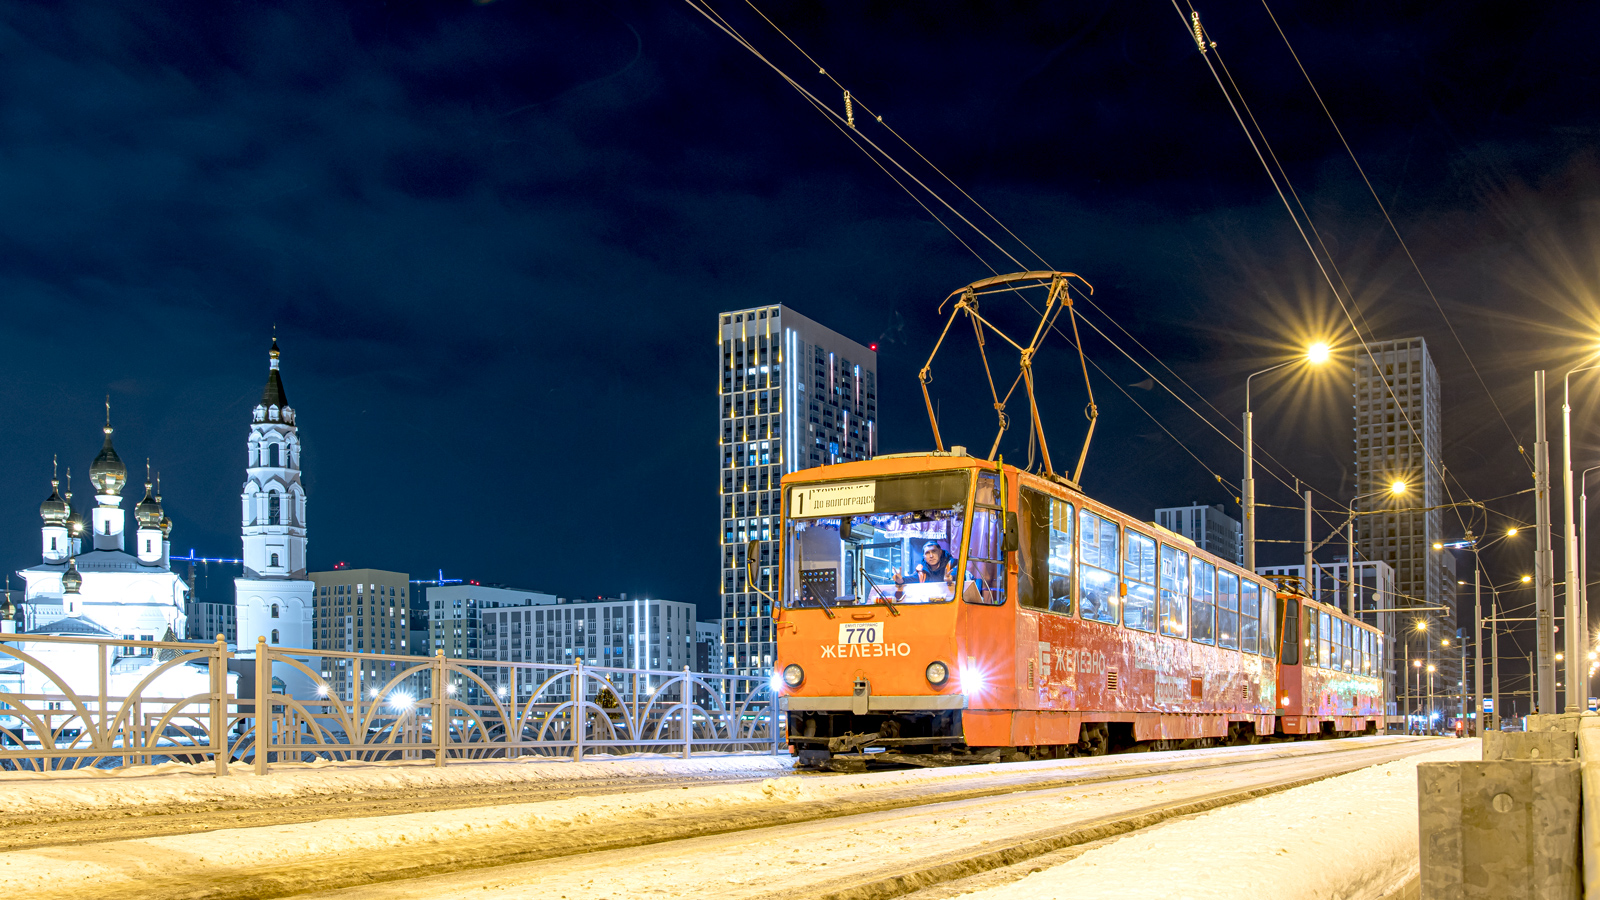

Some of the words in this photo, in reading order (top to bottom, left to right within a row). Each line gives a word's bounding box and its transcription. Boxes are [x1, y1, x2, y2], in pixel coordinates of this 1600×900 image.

[798, 492, 804, 515] 1
[846, 627, 876, 644] 770
[820, 642, 911, 659] ЖЕЛЕЗНО
[1055, 649, 1106, 675] ЖЕЛЕЗНО
